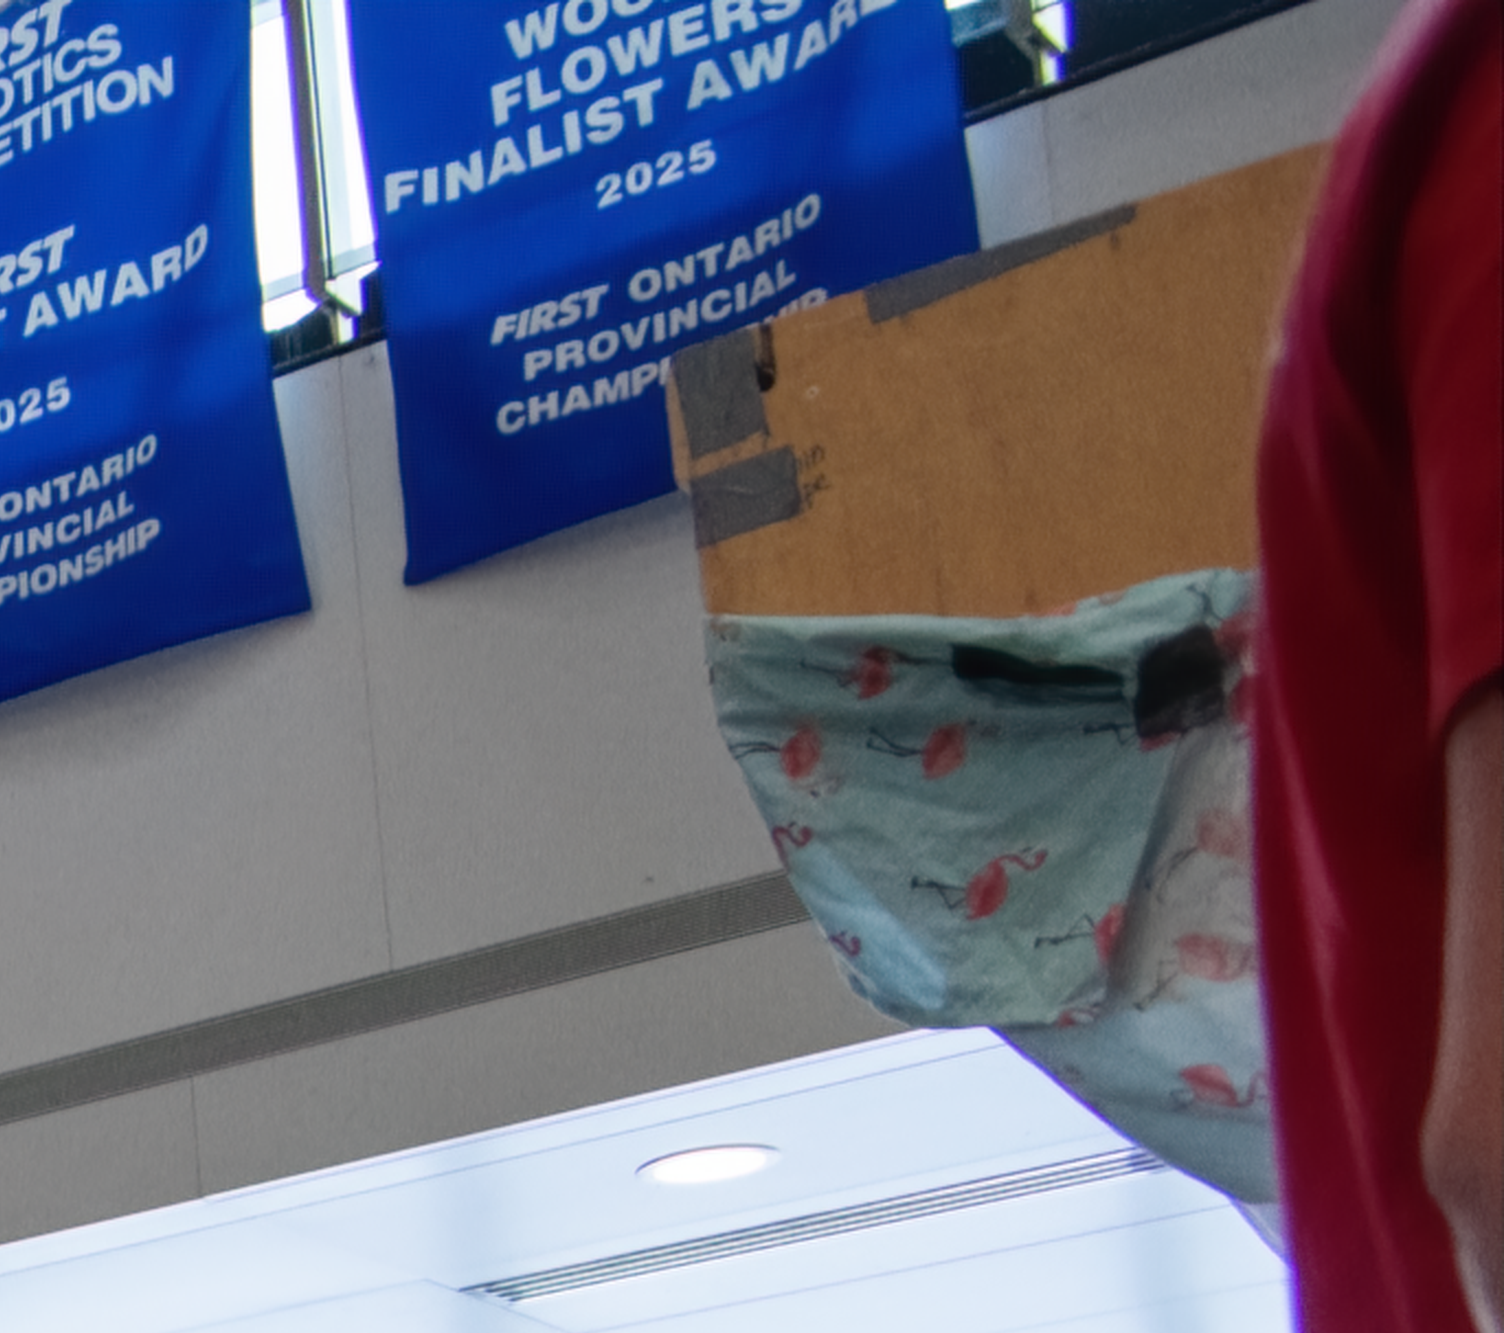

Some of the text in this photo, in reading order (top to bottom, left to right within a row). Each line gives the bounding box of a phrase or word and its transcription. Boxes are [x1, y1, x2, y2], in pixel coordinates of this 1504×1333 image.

[384, 78, 663, 213] FINALIST
[596, 139, 717, 210] 2025
[22, 223, 208, 338] AWARD
[491, 194, 821, 346] FIRST ONTARIO
[523, 259, 796, 382] PROVINCIAL
